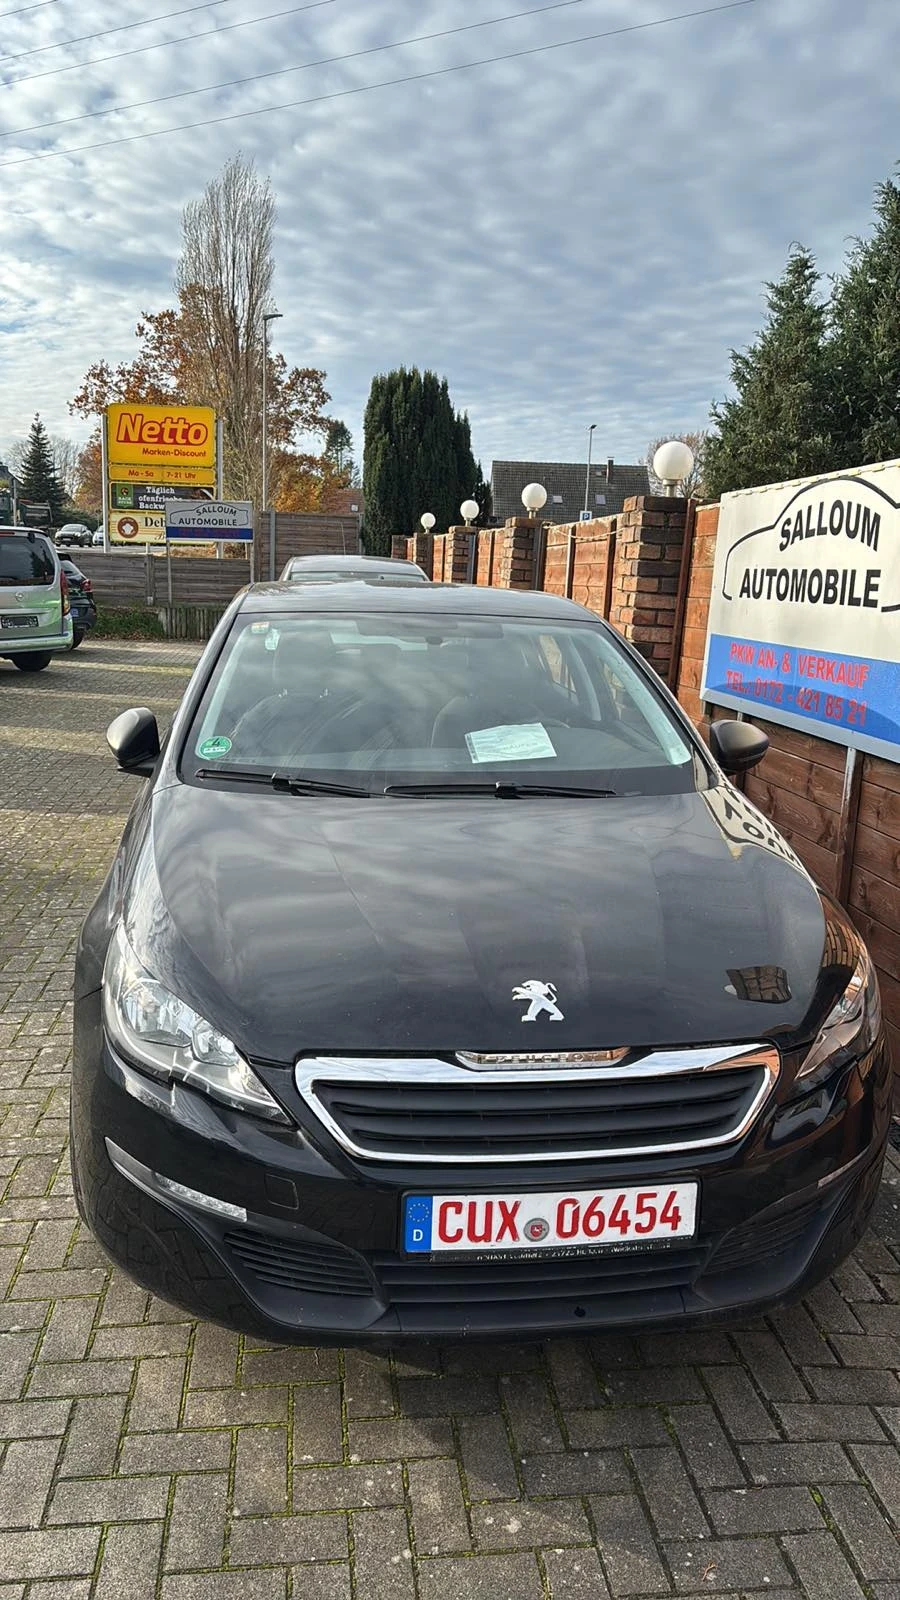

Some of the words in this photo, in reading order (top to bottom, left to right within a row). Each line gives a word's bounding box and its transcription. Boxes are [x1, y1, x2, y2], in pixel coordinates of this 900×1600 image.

[116, 412, 208, 447] Netto
[142, 447, 207, 458] Marken-Discount
[145, 486, 176, 495] Täglich
[178, 517, 238, 527] AUTOMOBILE
[195, 505, 237, 517] SALLOUM
[778, 499, 882, 553] SALLOUM
[739, 568, 882, 609] AUTOMOBILE
[731, 642, 755, 664] PKW
[781, 652, 791, 674] &
[798, 653, 869, 689] VERKAUF
[753, 677, 784, 705] 0172
[795, 686, 821, 712] 421
[824, 693, 844, 720] 85
[846, 698, 869, 726] 21
[437, 1200, 522, 1243] CUX
[555, 1190, 683, 1239] 06454
[412, 1229, 424, 1242] D
